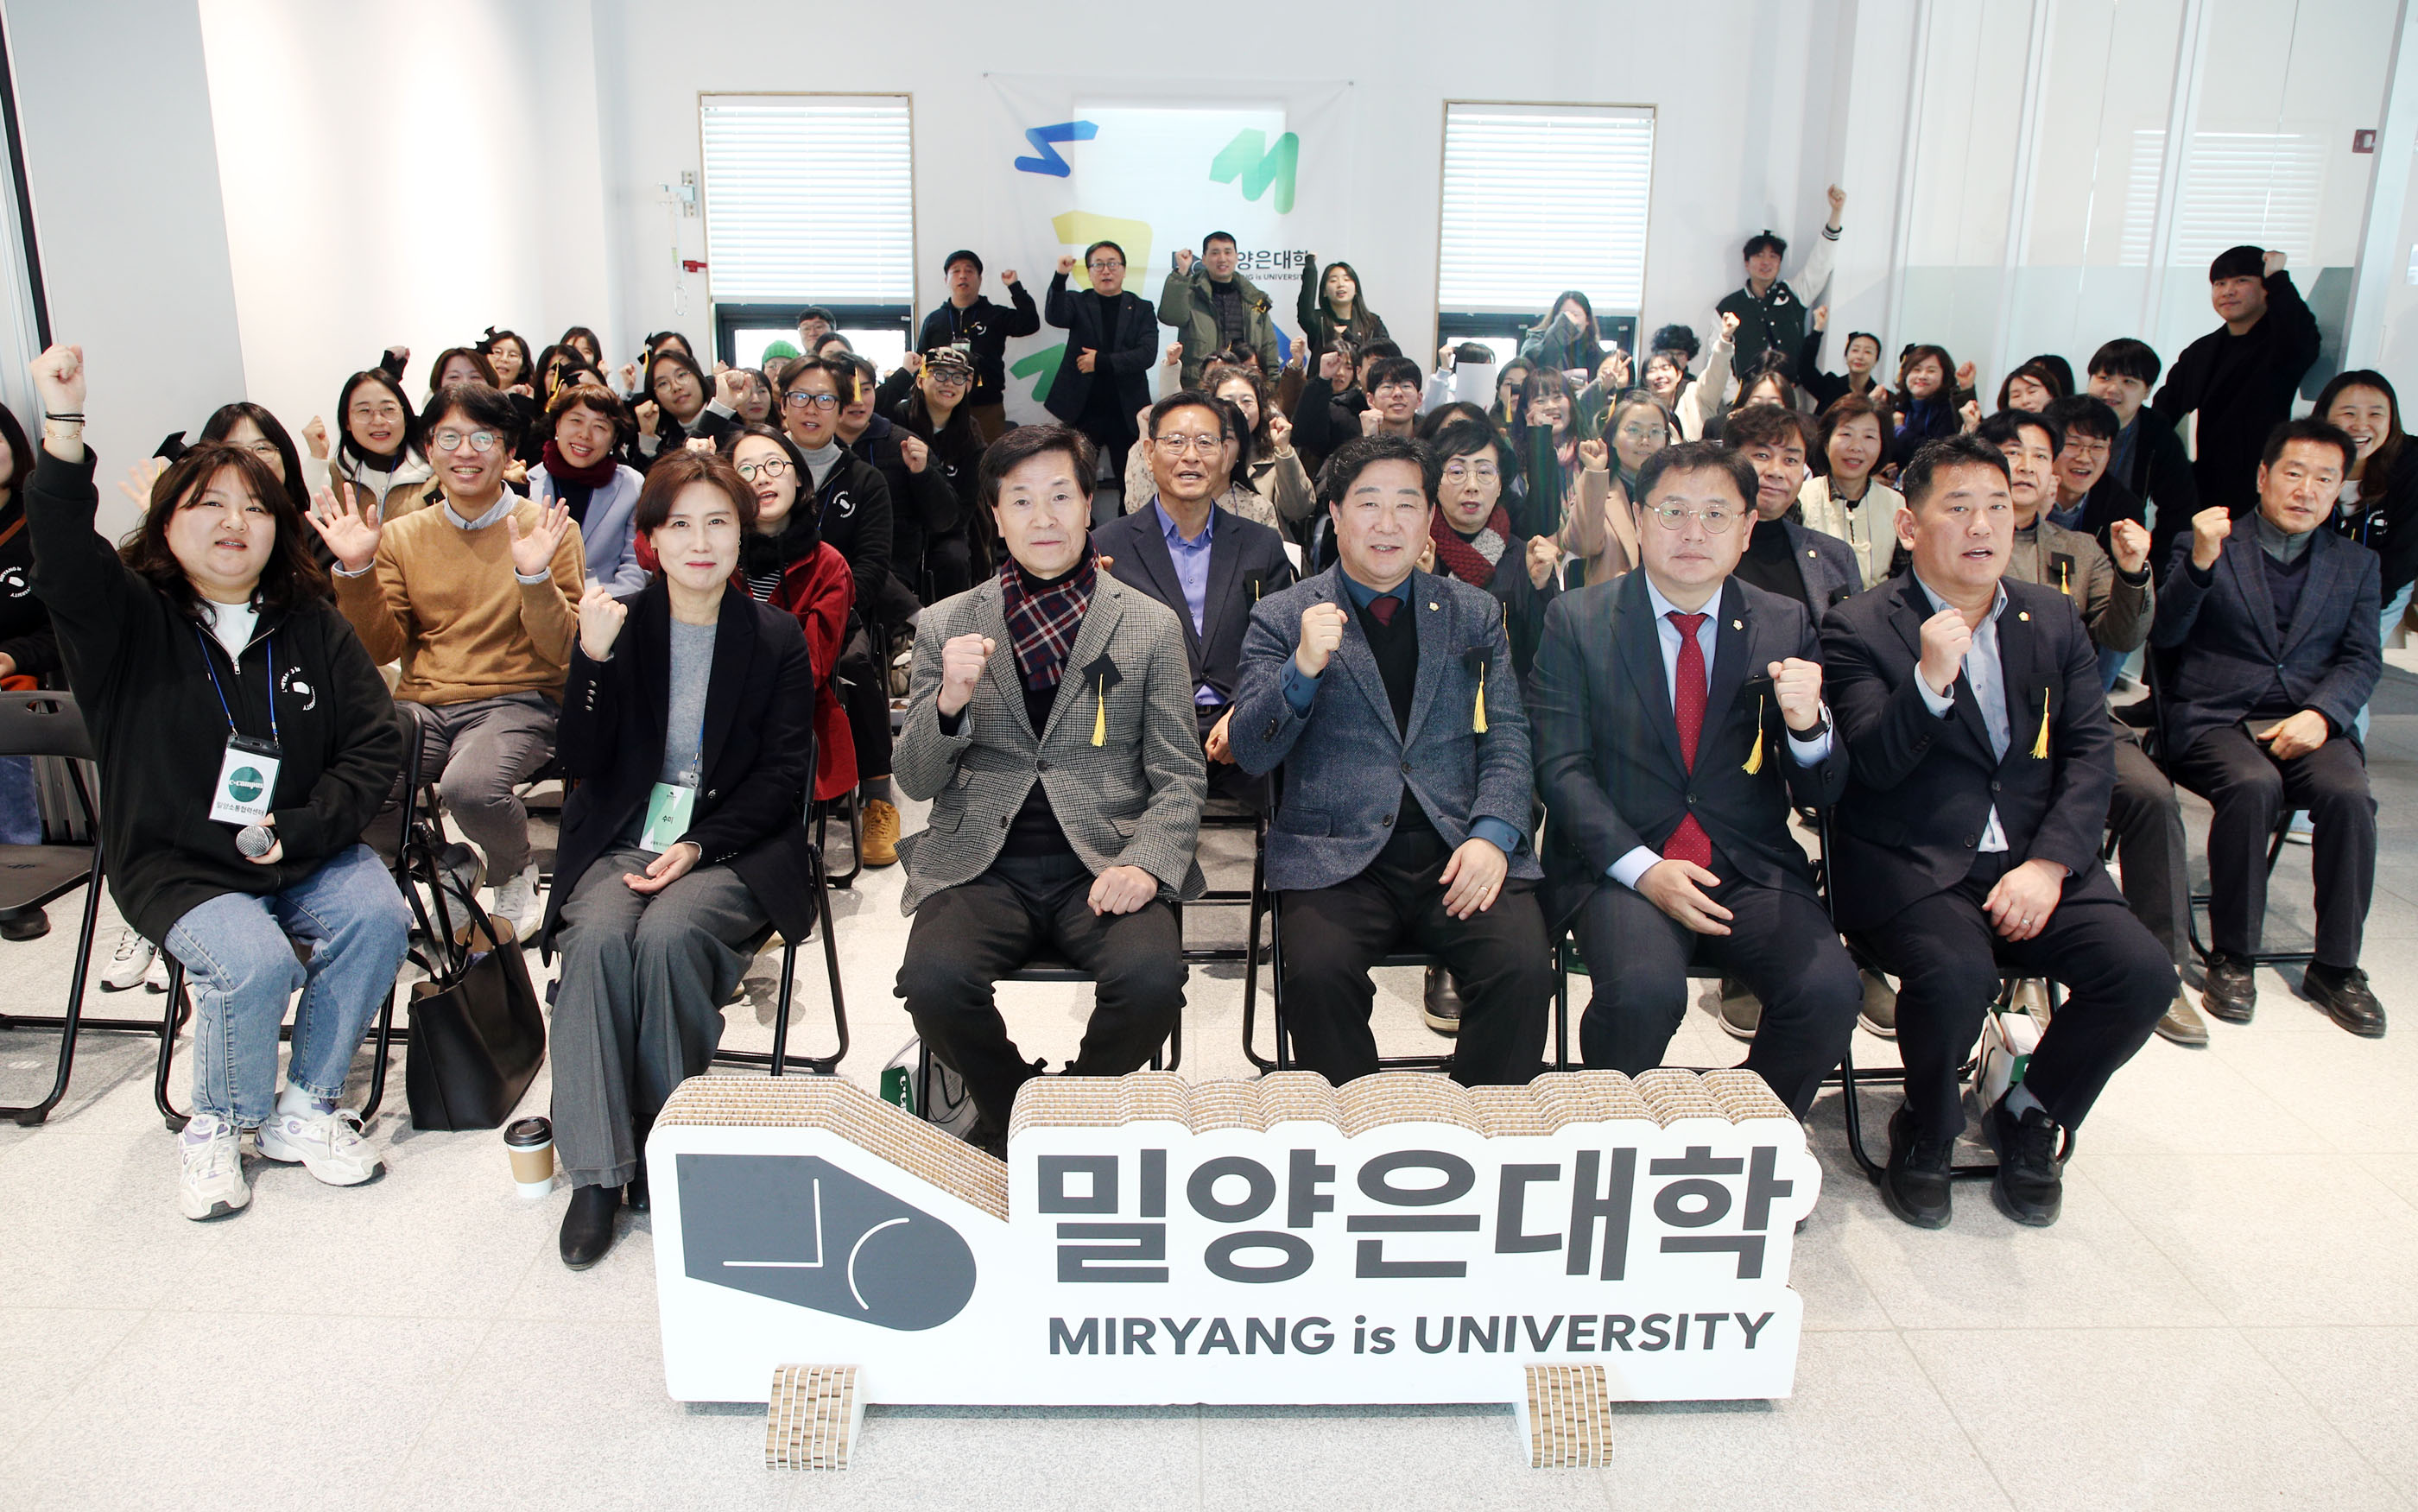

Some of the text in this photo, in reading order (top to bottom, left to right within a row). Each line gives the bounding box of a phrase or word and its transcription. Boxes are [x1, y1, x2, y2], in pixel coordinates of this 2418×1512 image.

[1237, 250, 1308, 270] 양은대학
[1038, 1146, 1794, 1283] 밀양은대학
[1049, 1312, 1775, 1356] MIRYANG is UNIVERSITY
